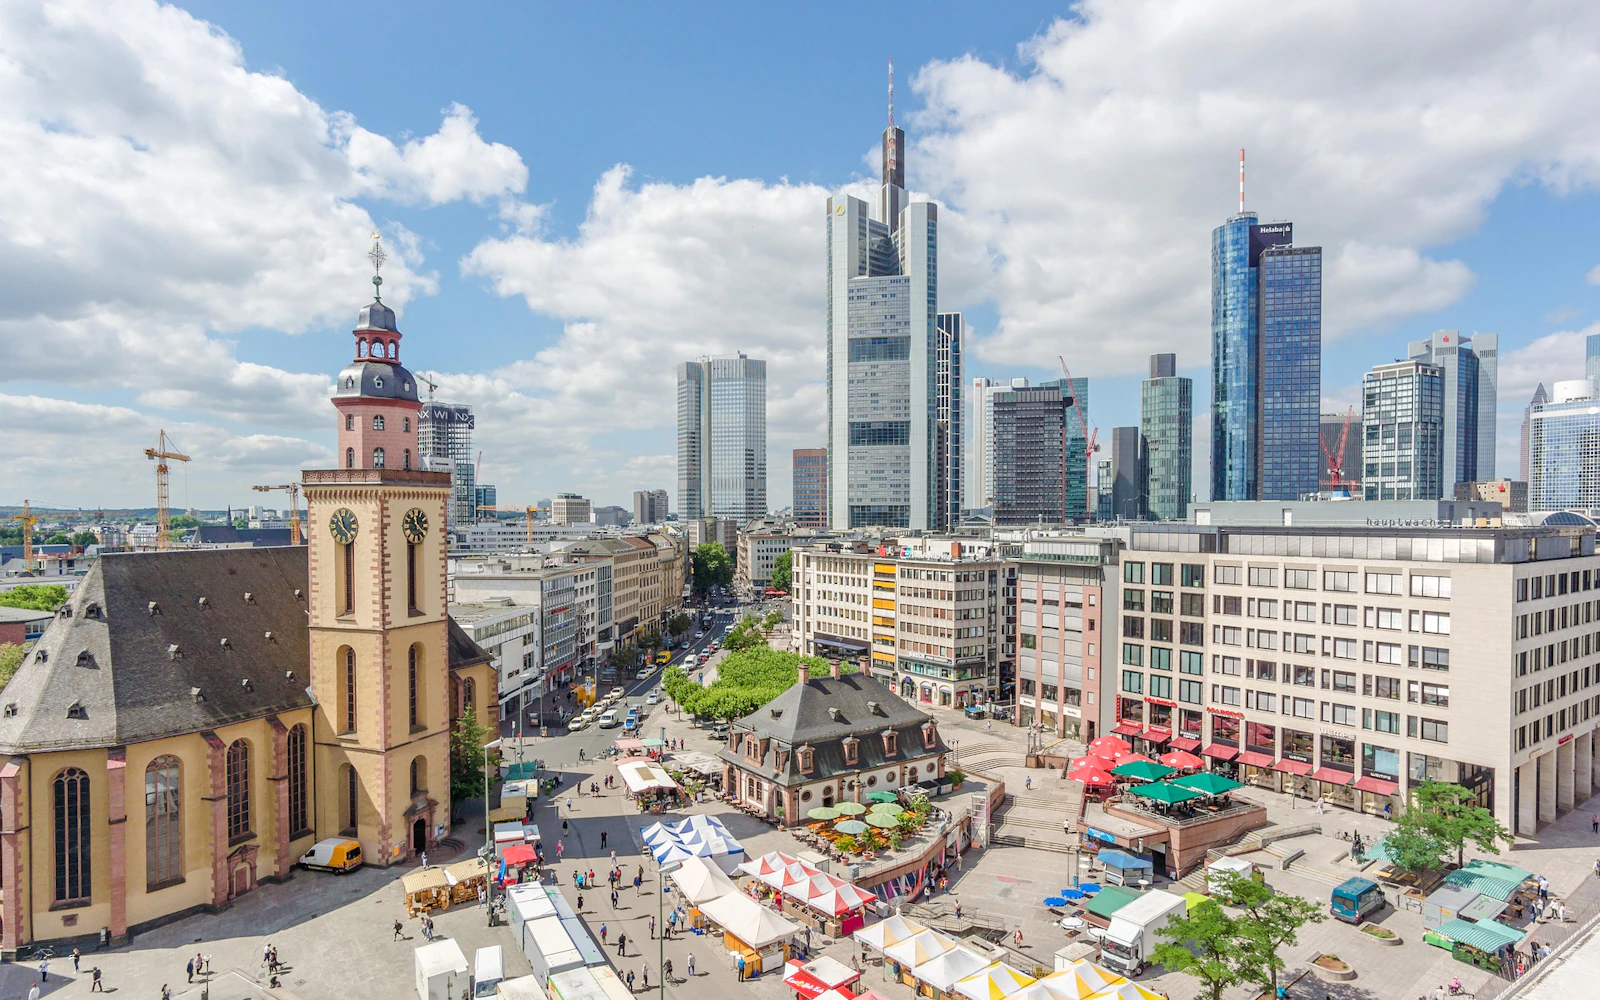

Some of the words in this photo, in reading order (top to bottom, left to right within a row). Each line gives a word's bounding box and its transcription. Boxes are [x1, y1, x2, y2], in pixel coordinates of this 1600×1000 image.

[1206, 707, 1244, 719] MAREDO
[1319, 728, 1356, 741] WEMPE
[1288, 754, 1308, 763] WEMPE
[1370, 772, 1392, 781] WEMPE
